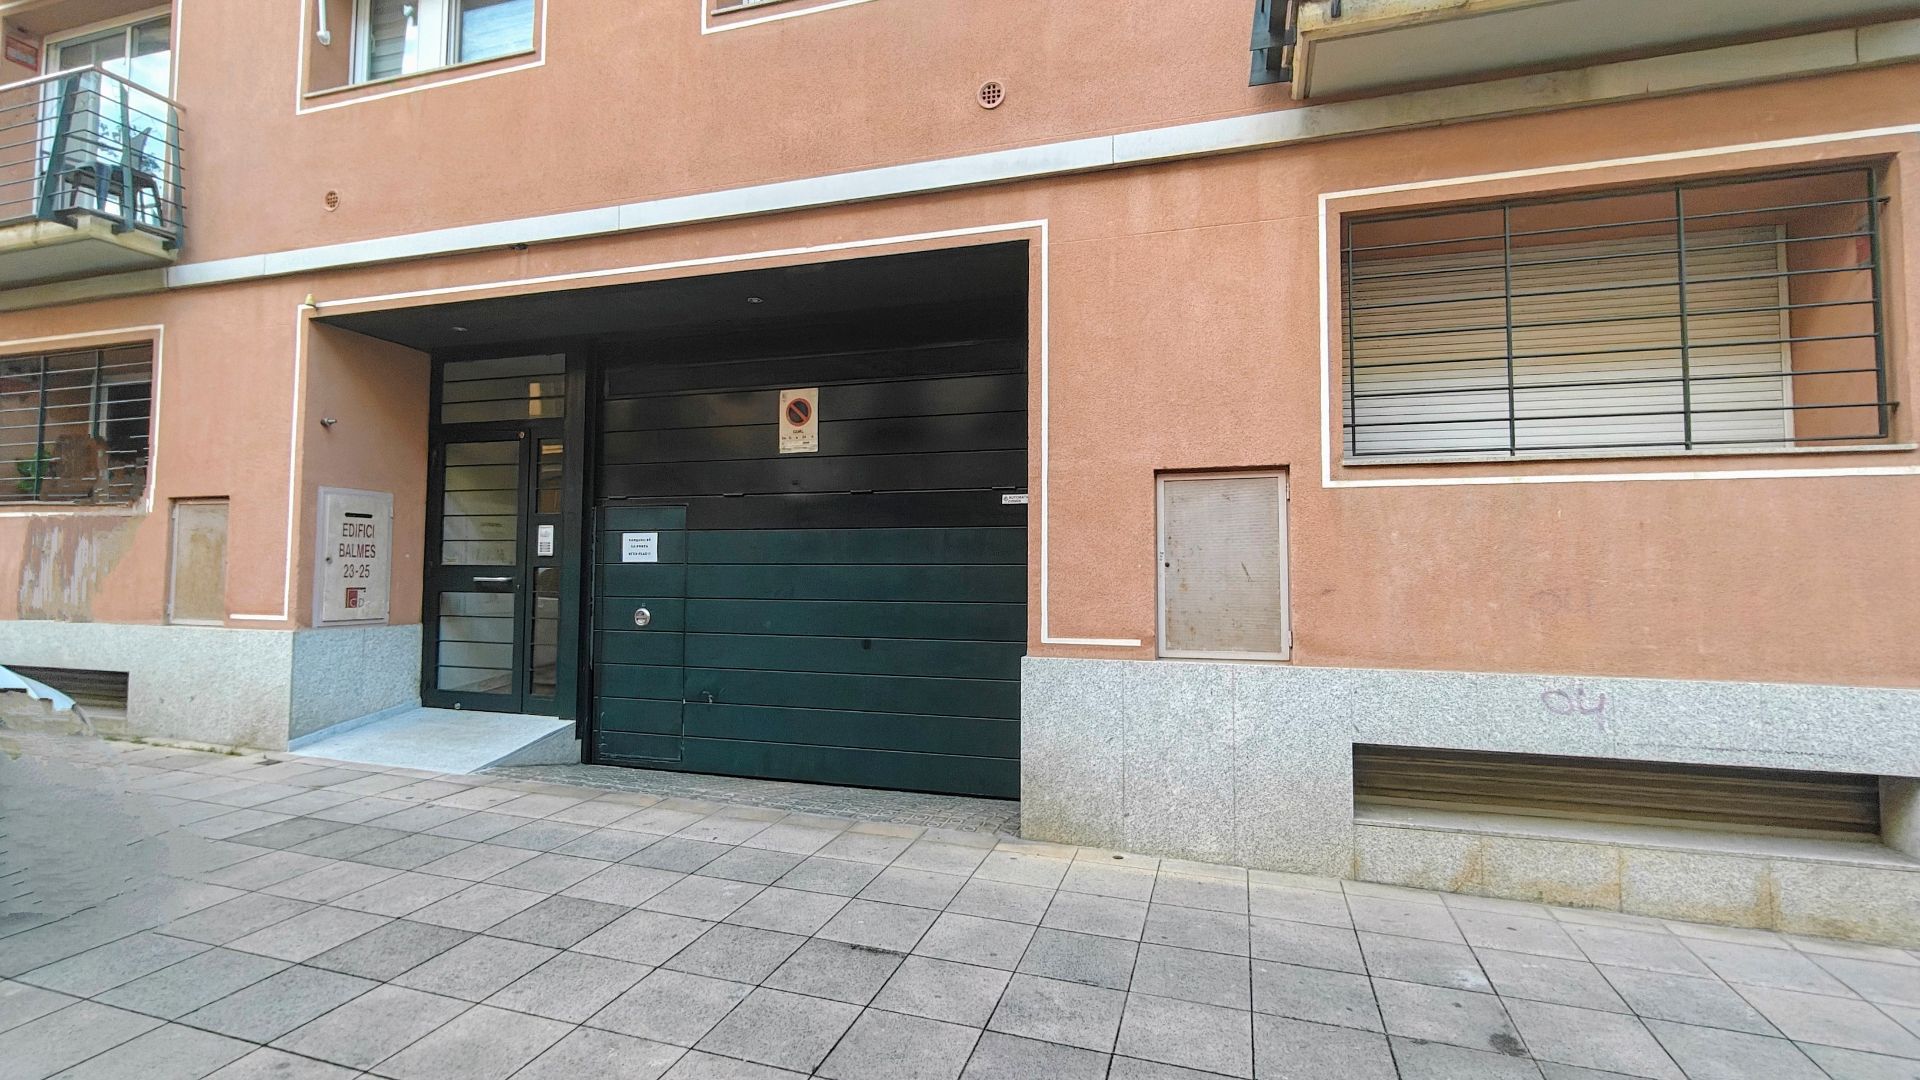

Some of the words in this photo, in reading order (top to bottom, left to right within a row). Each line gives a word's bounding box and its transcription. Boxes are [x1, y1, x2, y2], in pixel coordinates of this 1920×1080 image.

[342, 522, 375, 538] EDIFICI
[339, 543, 376, 559] BALMES
[343, 564, 370, 578] 23-25
